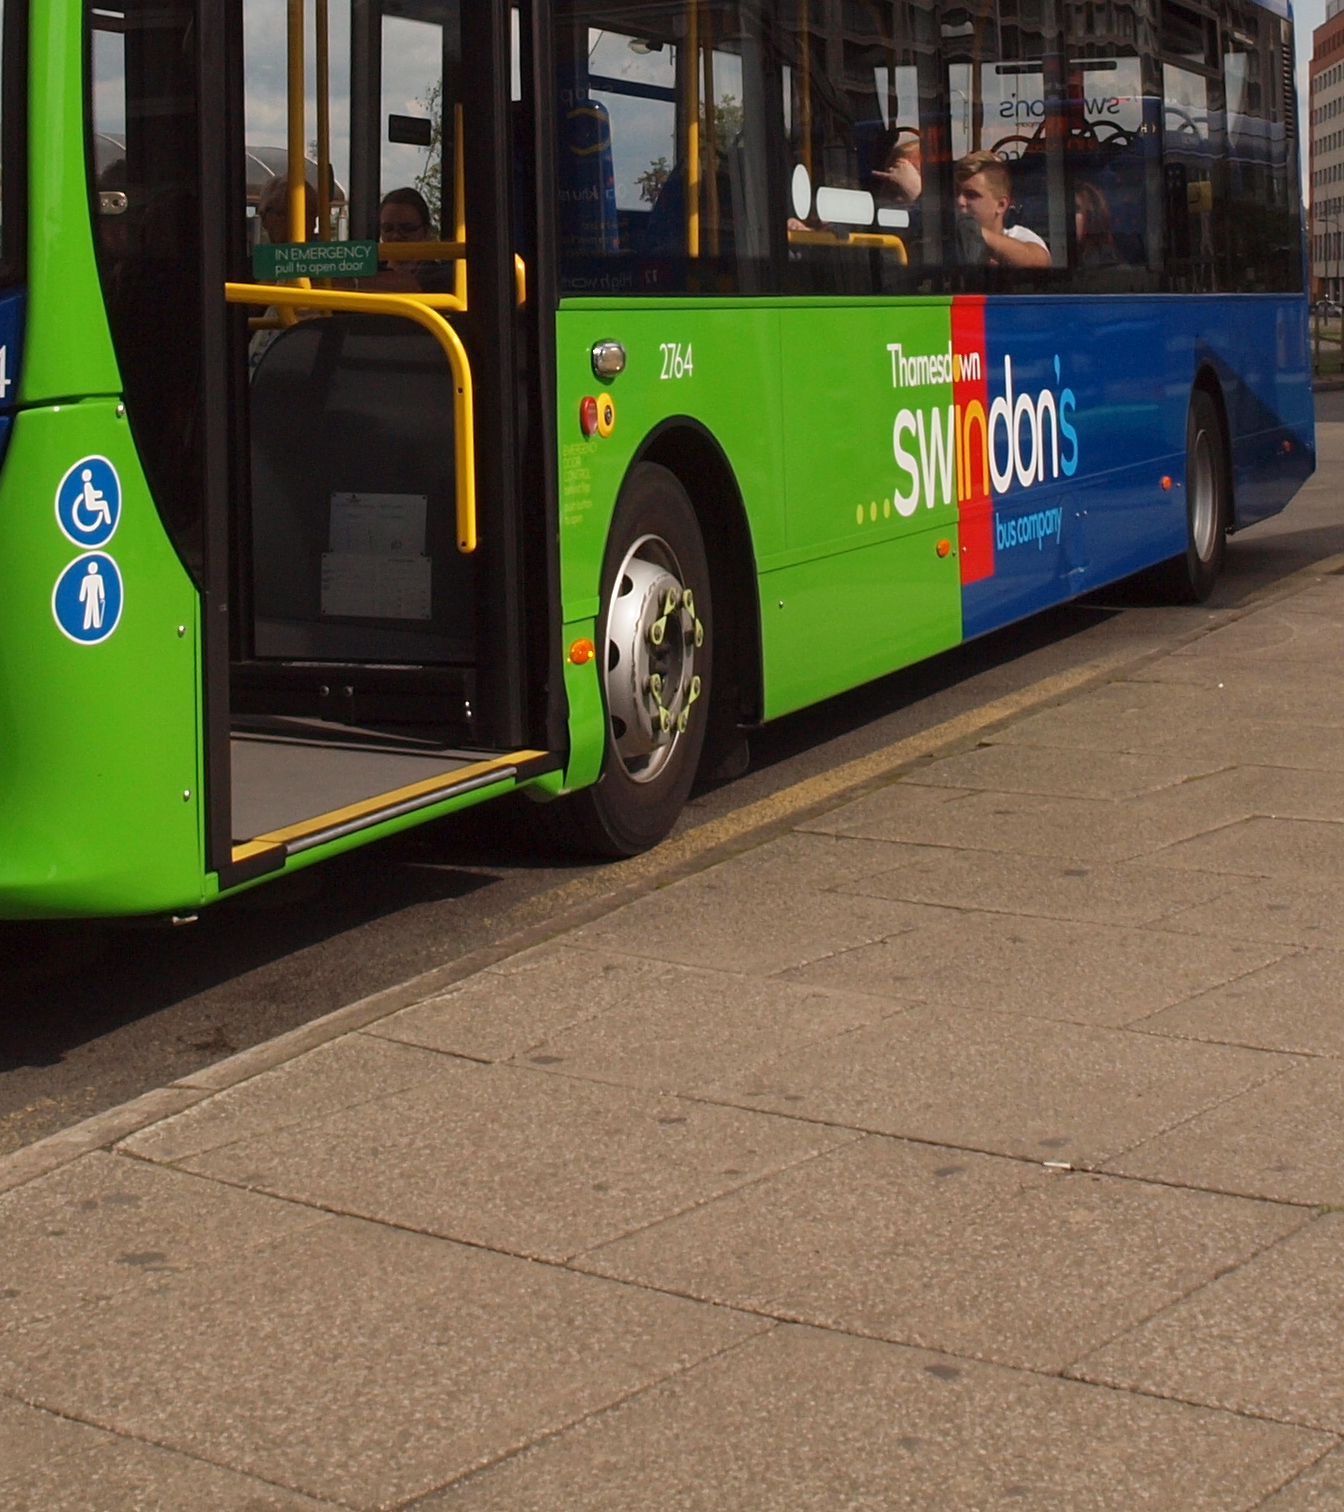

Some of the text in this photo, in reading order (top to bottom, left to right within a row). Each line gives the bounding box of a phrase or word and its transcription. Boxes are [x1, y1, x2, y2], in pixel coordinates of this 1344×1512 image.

[274, 245, 372, 261] IN EMERGENCY
[274, 259, 364, 277] pull to open door
[659, 342, 694, 380] 2764
[886, 340, 981, 388] Thamesdown
[995, 506, 1063, 552] bus company
